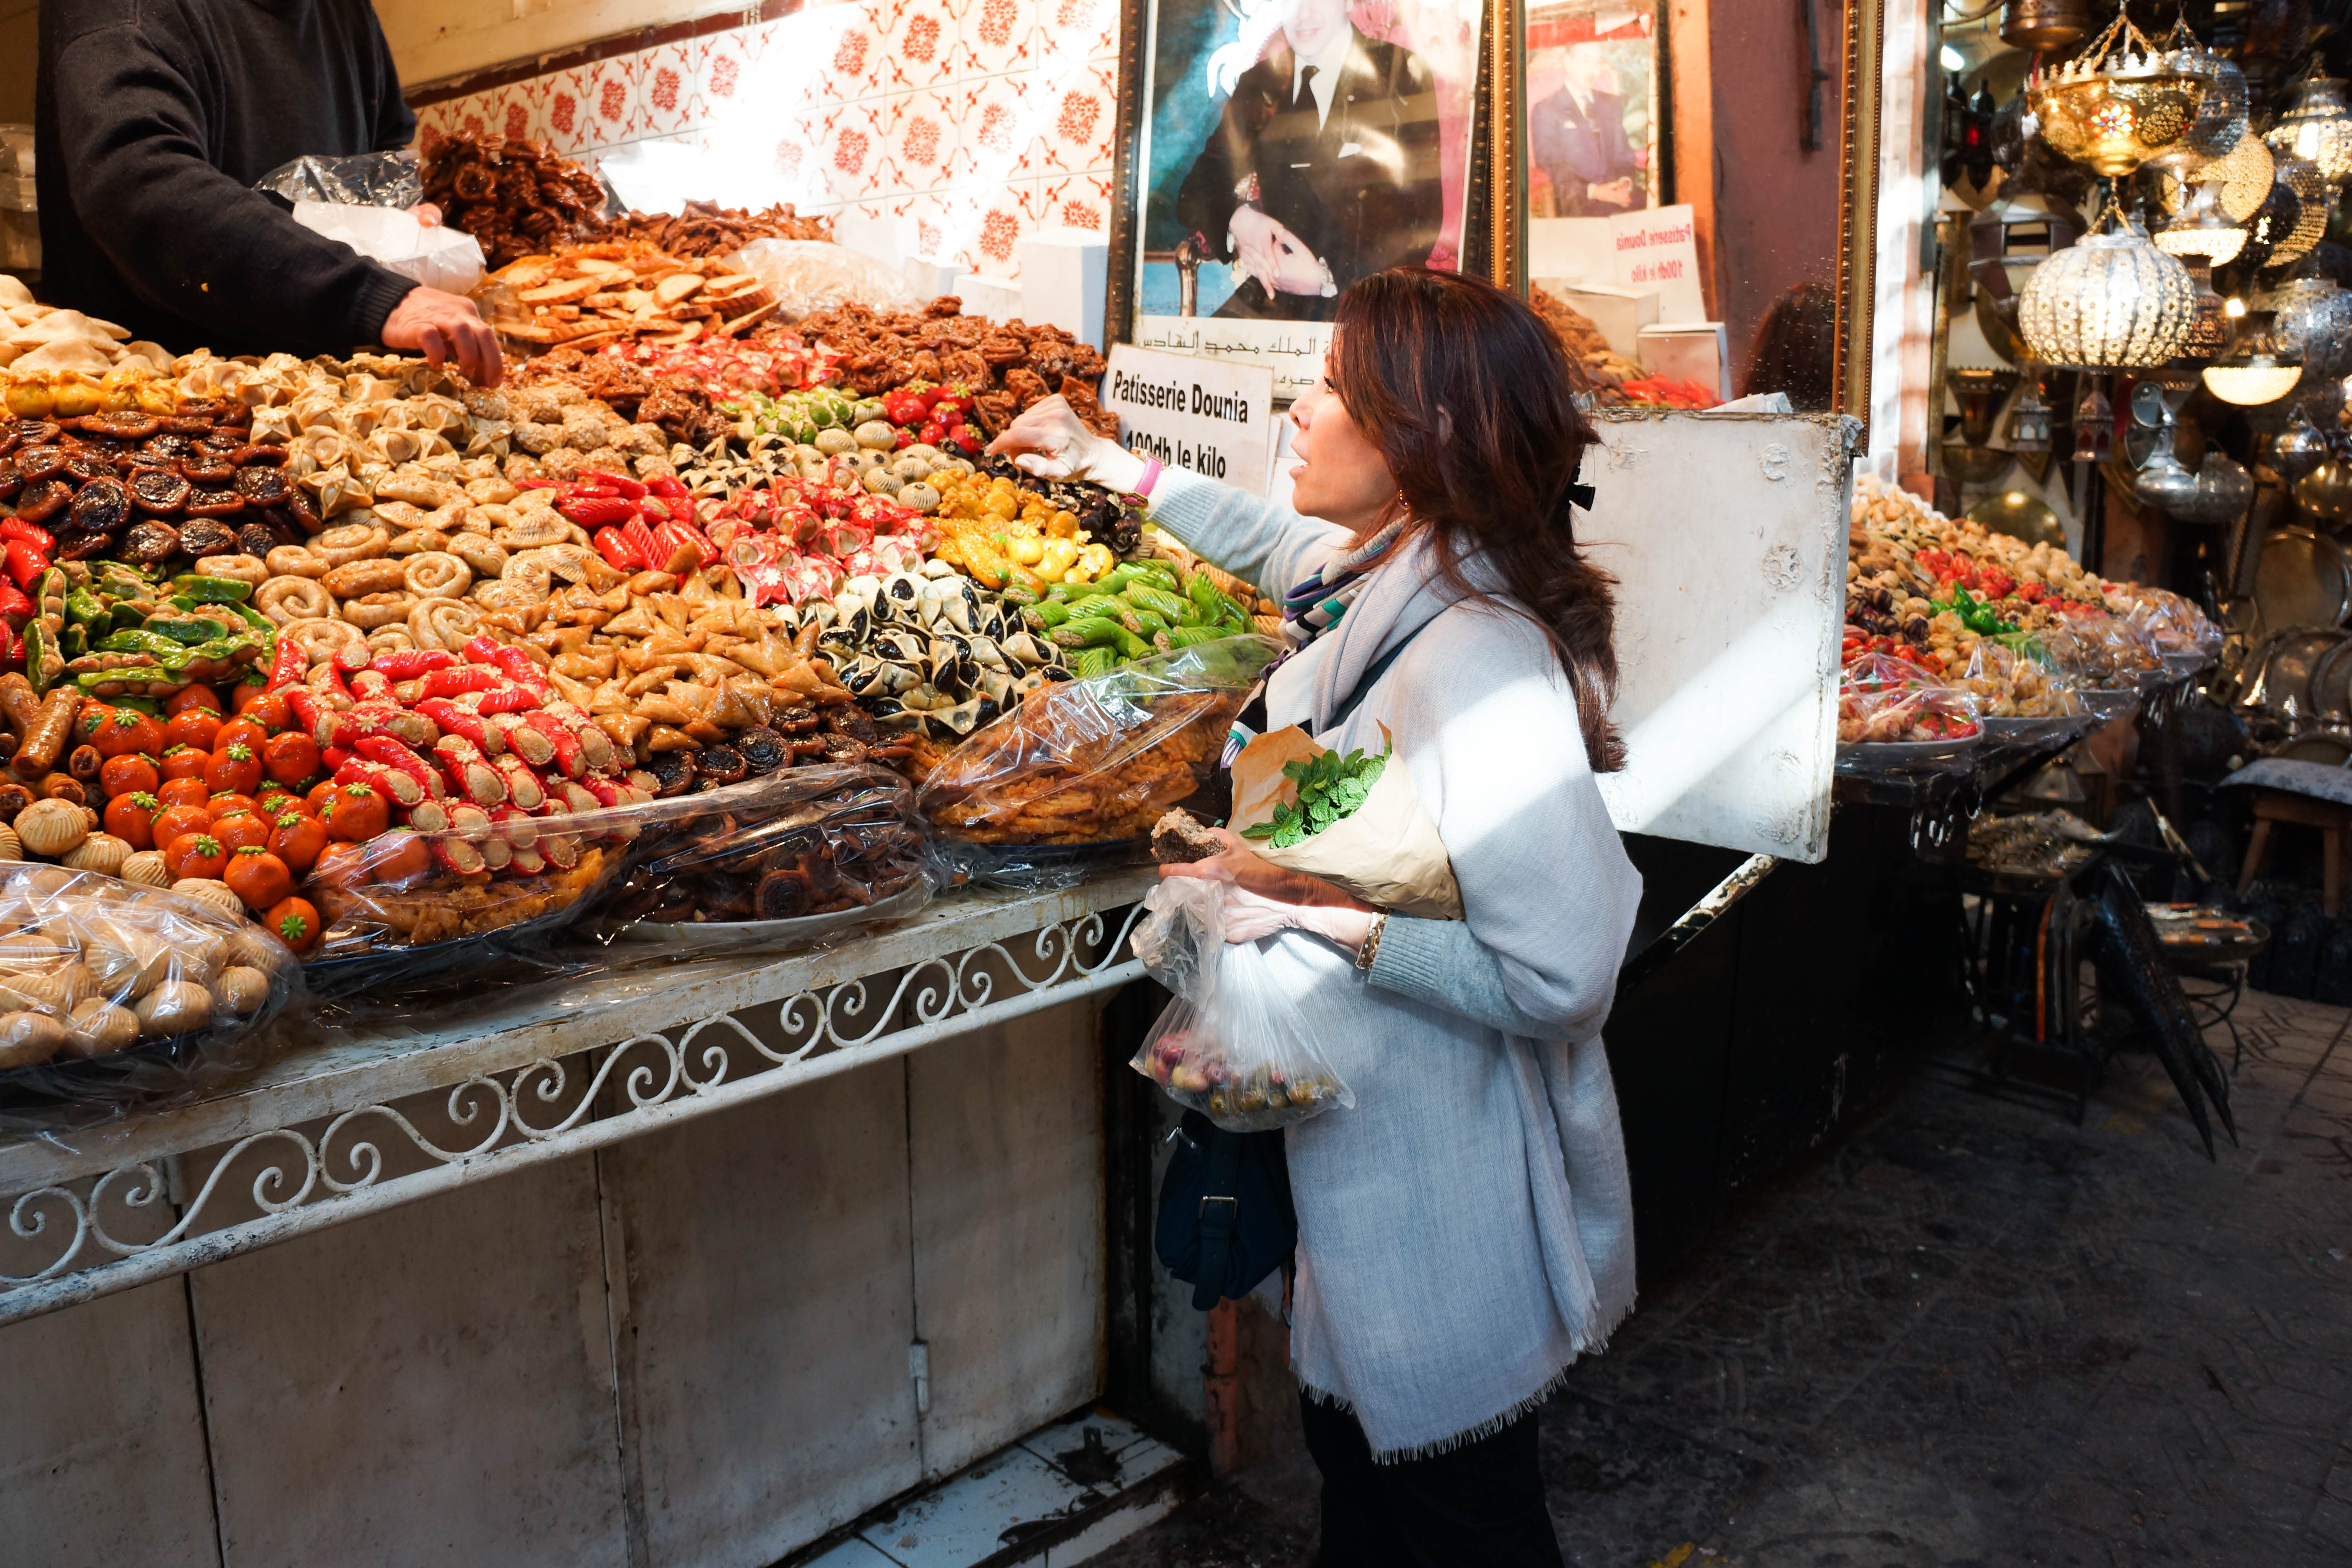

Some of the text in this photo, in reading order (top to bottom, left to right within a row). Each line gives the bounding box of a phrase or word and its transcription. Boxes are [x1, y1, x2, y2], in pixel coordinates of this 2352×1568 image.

[1204, 339, 1259, 355] محمد
[1267, 335, 1316, 358] الملك
[1112, 370, 1248, 424] Patisserie Dounia
[1178, 440, 1191, 469] le
[1197, 444, 1226, 479] kilo
